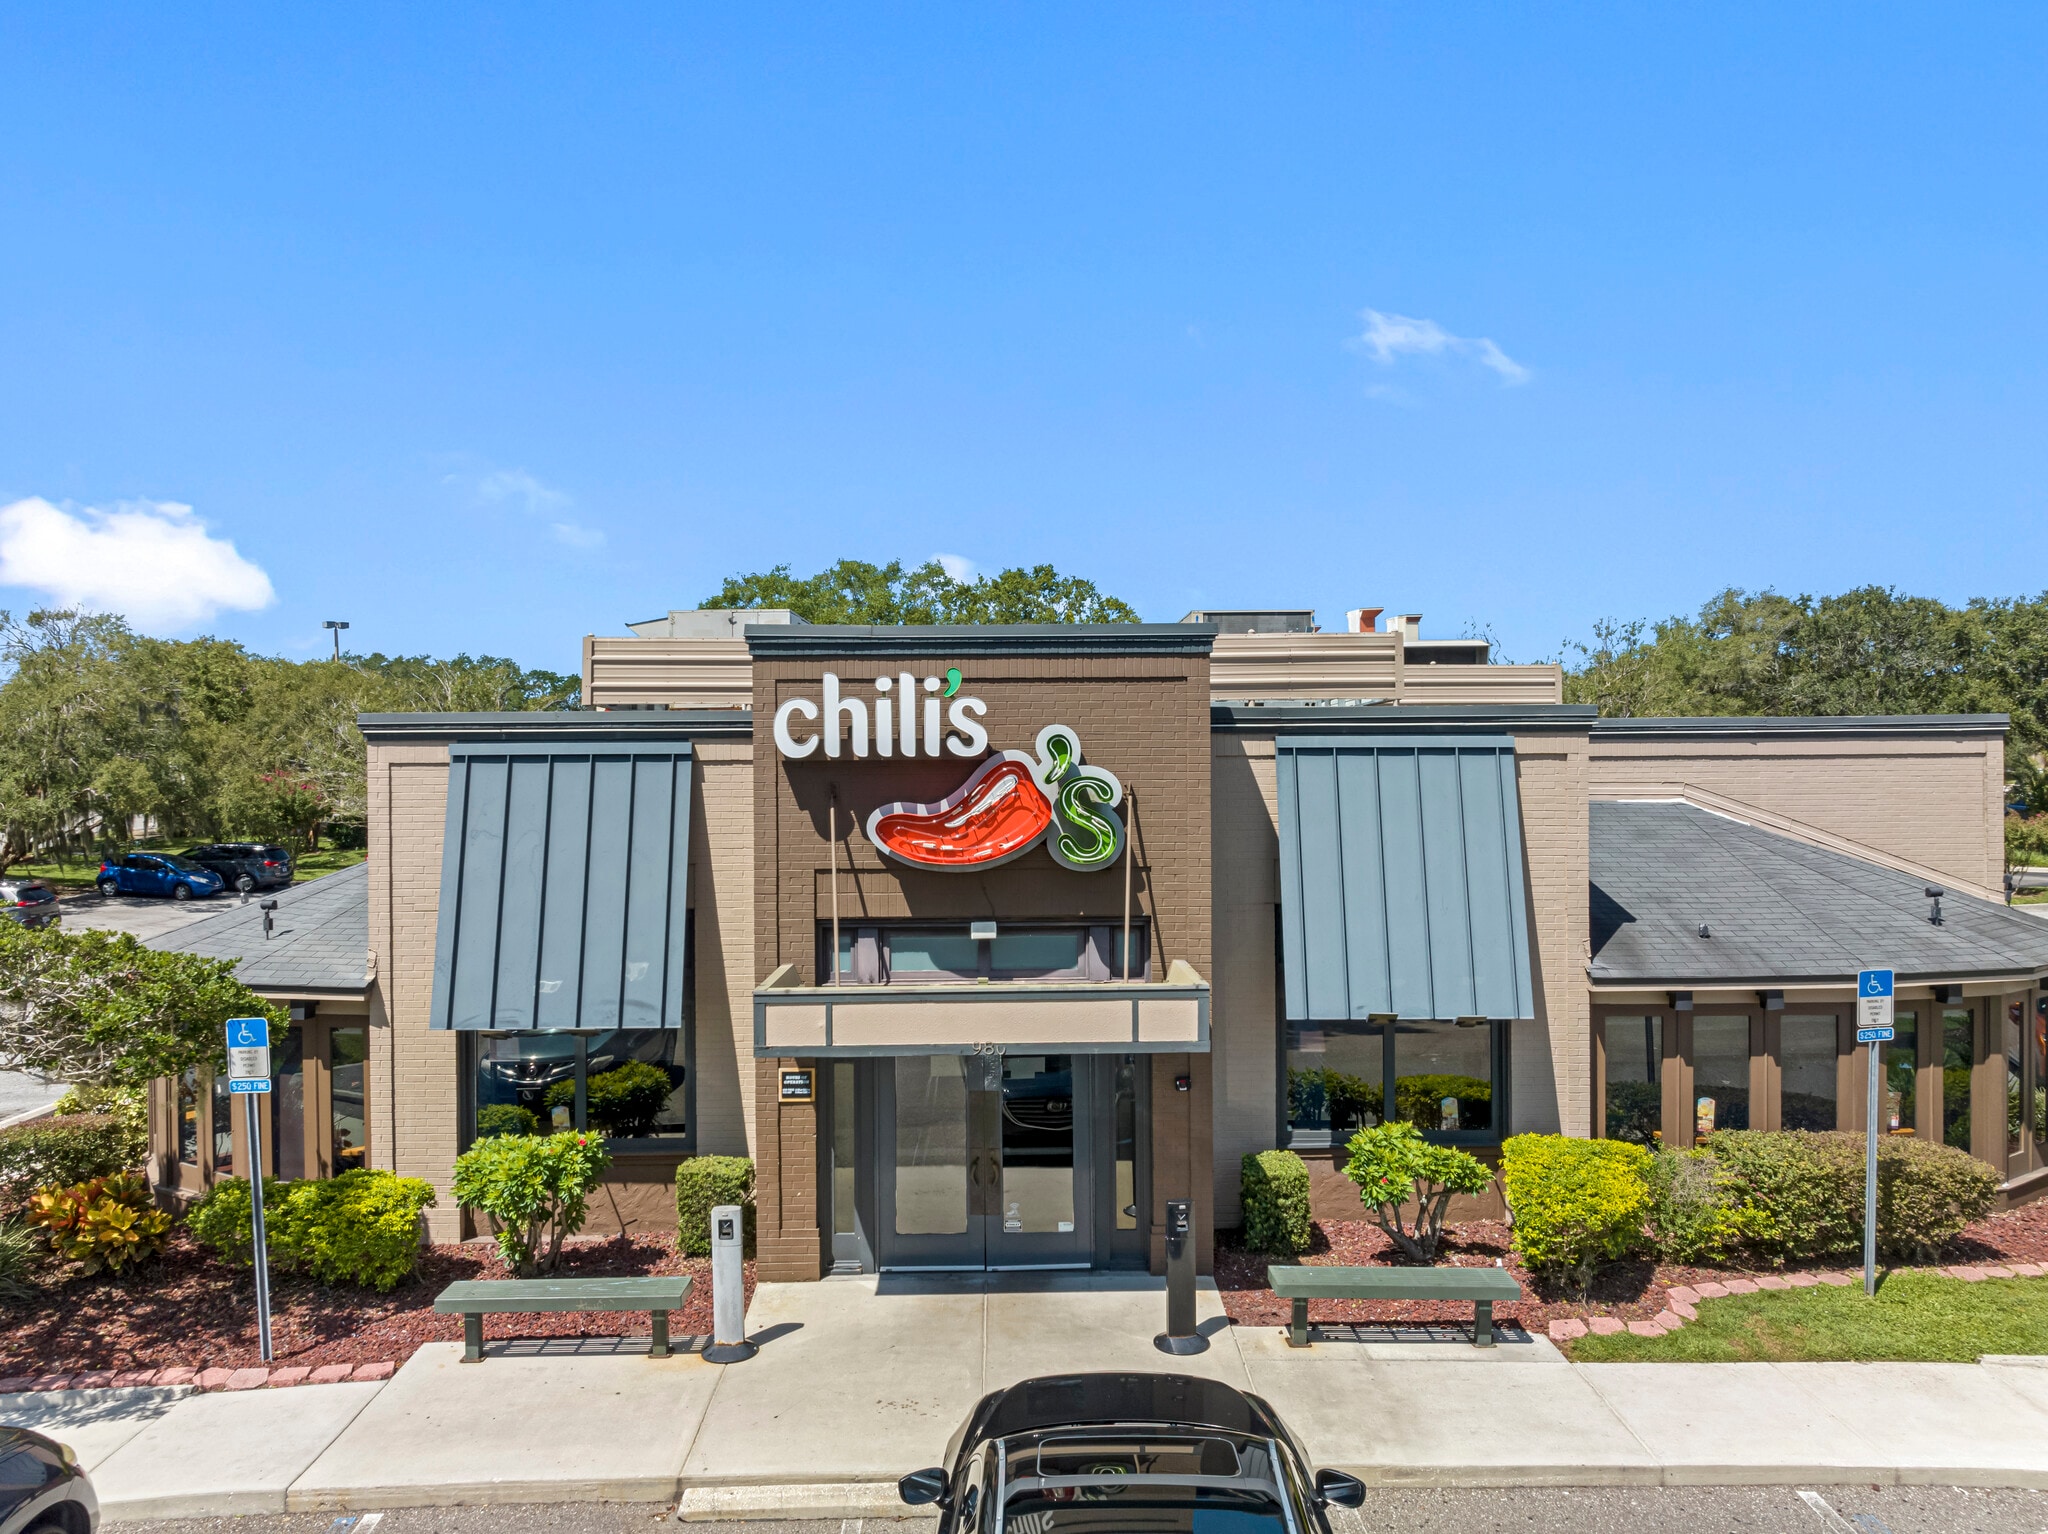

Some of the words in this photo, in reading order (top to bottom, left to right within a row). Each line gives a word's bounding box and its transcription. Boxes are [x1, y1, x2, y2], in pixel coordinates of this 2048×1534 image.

[773, 667, 988, 759] chili's
[1860, 1030, 1876, 1040] $250
[1877, 1029, 1892, 1039] FINE
[231, 1081, 252, 1091] $250
[253, 1081, 269, 1090] FINE
